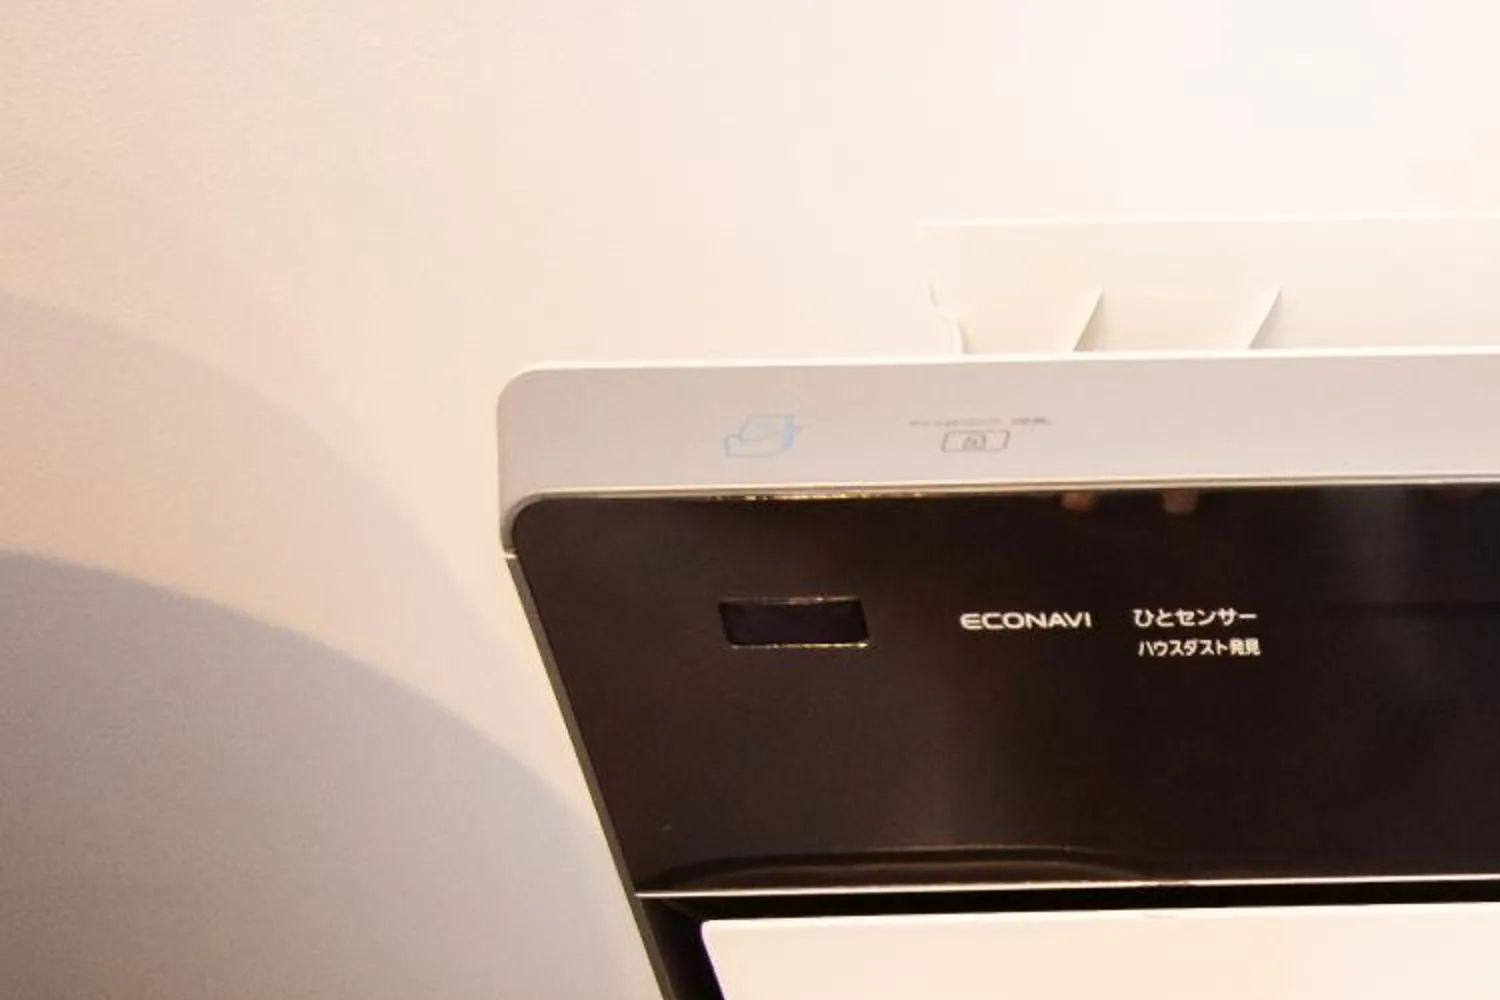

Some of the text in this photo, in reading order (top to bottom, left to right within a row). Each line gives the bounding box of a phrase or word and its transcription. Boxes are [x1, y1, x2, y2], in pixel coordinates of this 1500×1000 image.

[960, 611, 1092, 630] ECONAVI
[1133, 608, 1258, 628] ひとセンサー
[1138, 638, 1261, 657] ハウスダスト発見
